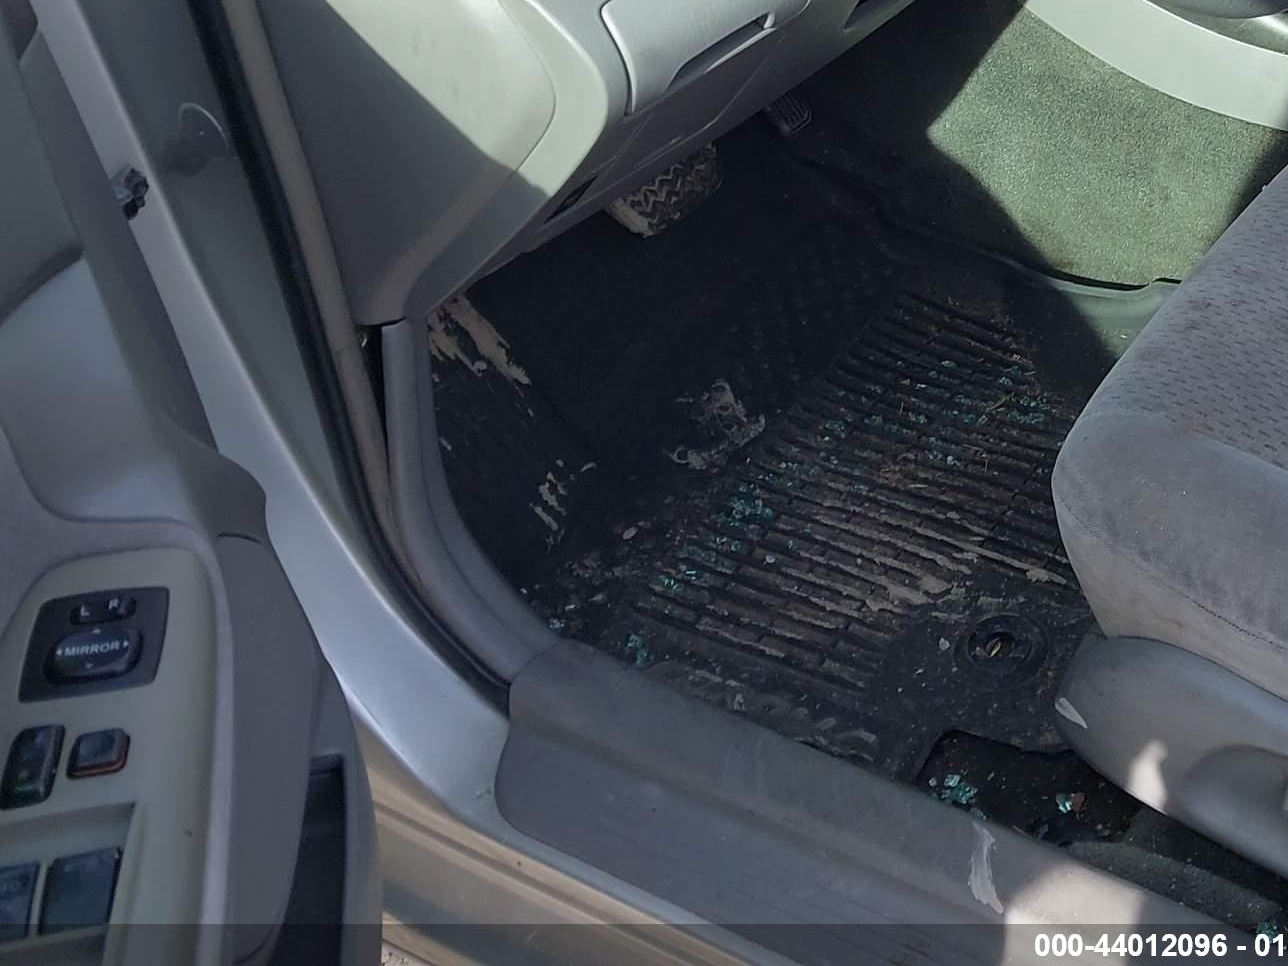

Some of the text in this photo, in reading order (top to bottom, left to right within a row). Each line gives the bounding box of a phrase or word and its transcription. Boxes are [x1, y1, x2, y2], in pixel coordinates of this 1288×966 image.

[80, 598, 119, 617] L R
[64, 640, 121, 656] MIRROR
